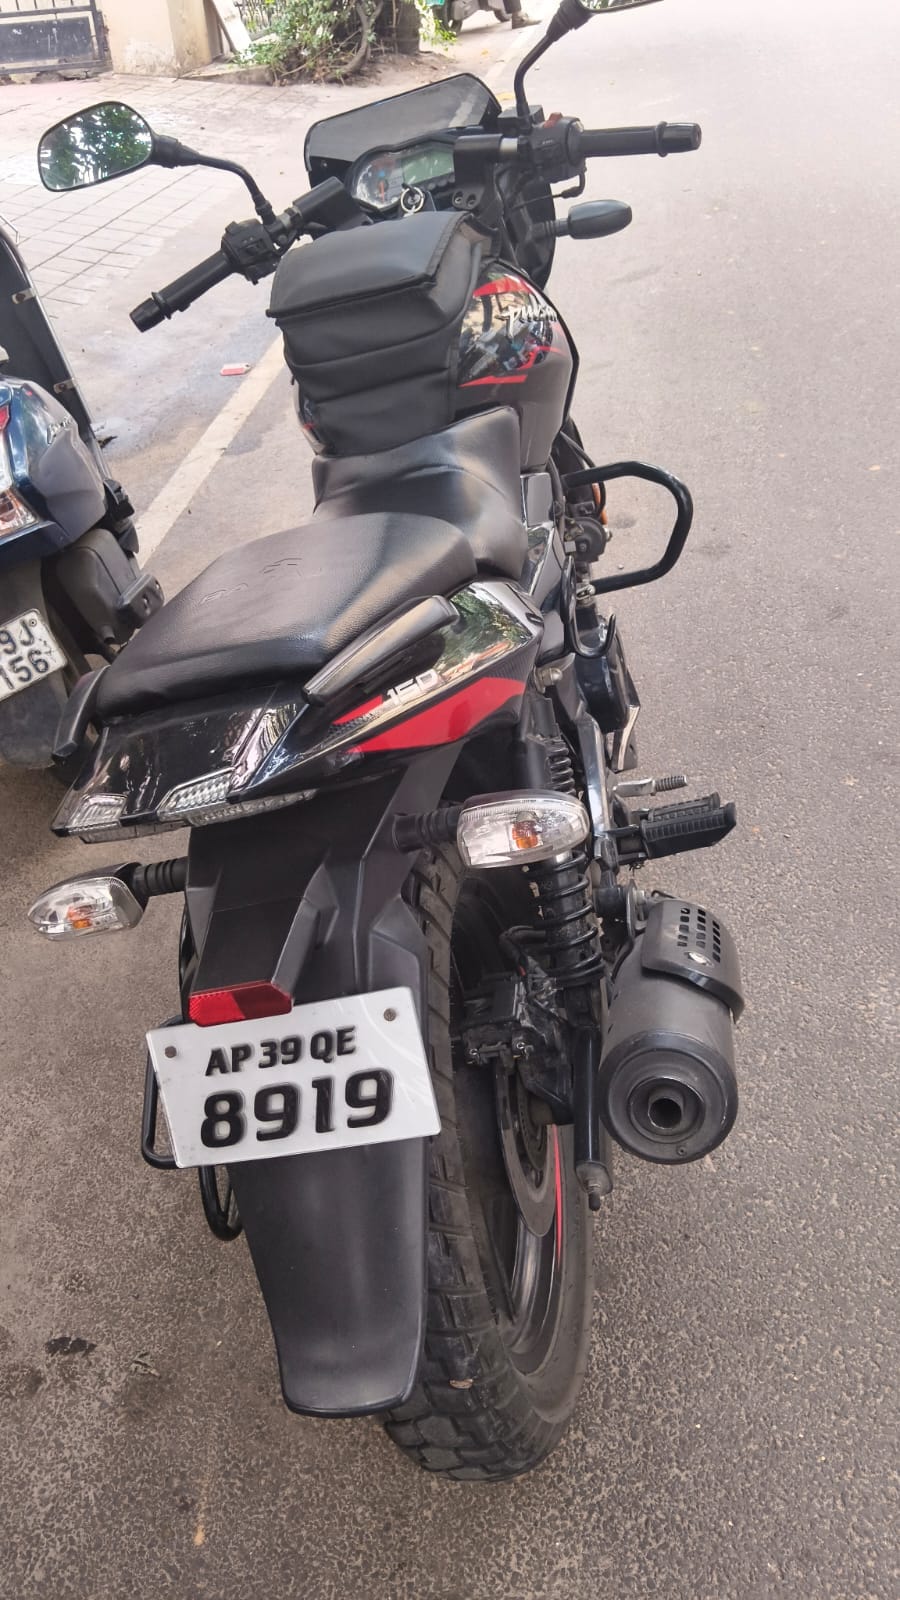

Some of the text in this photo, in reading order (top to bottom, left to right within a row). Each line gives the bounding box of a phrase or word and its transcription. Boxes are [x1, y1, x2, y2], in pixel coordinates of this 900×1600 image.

[205, 1025, 356, 1076] AP 39 QE
[200, 1067, 394, 1148] 8919
